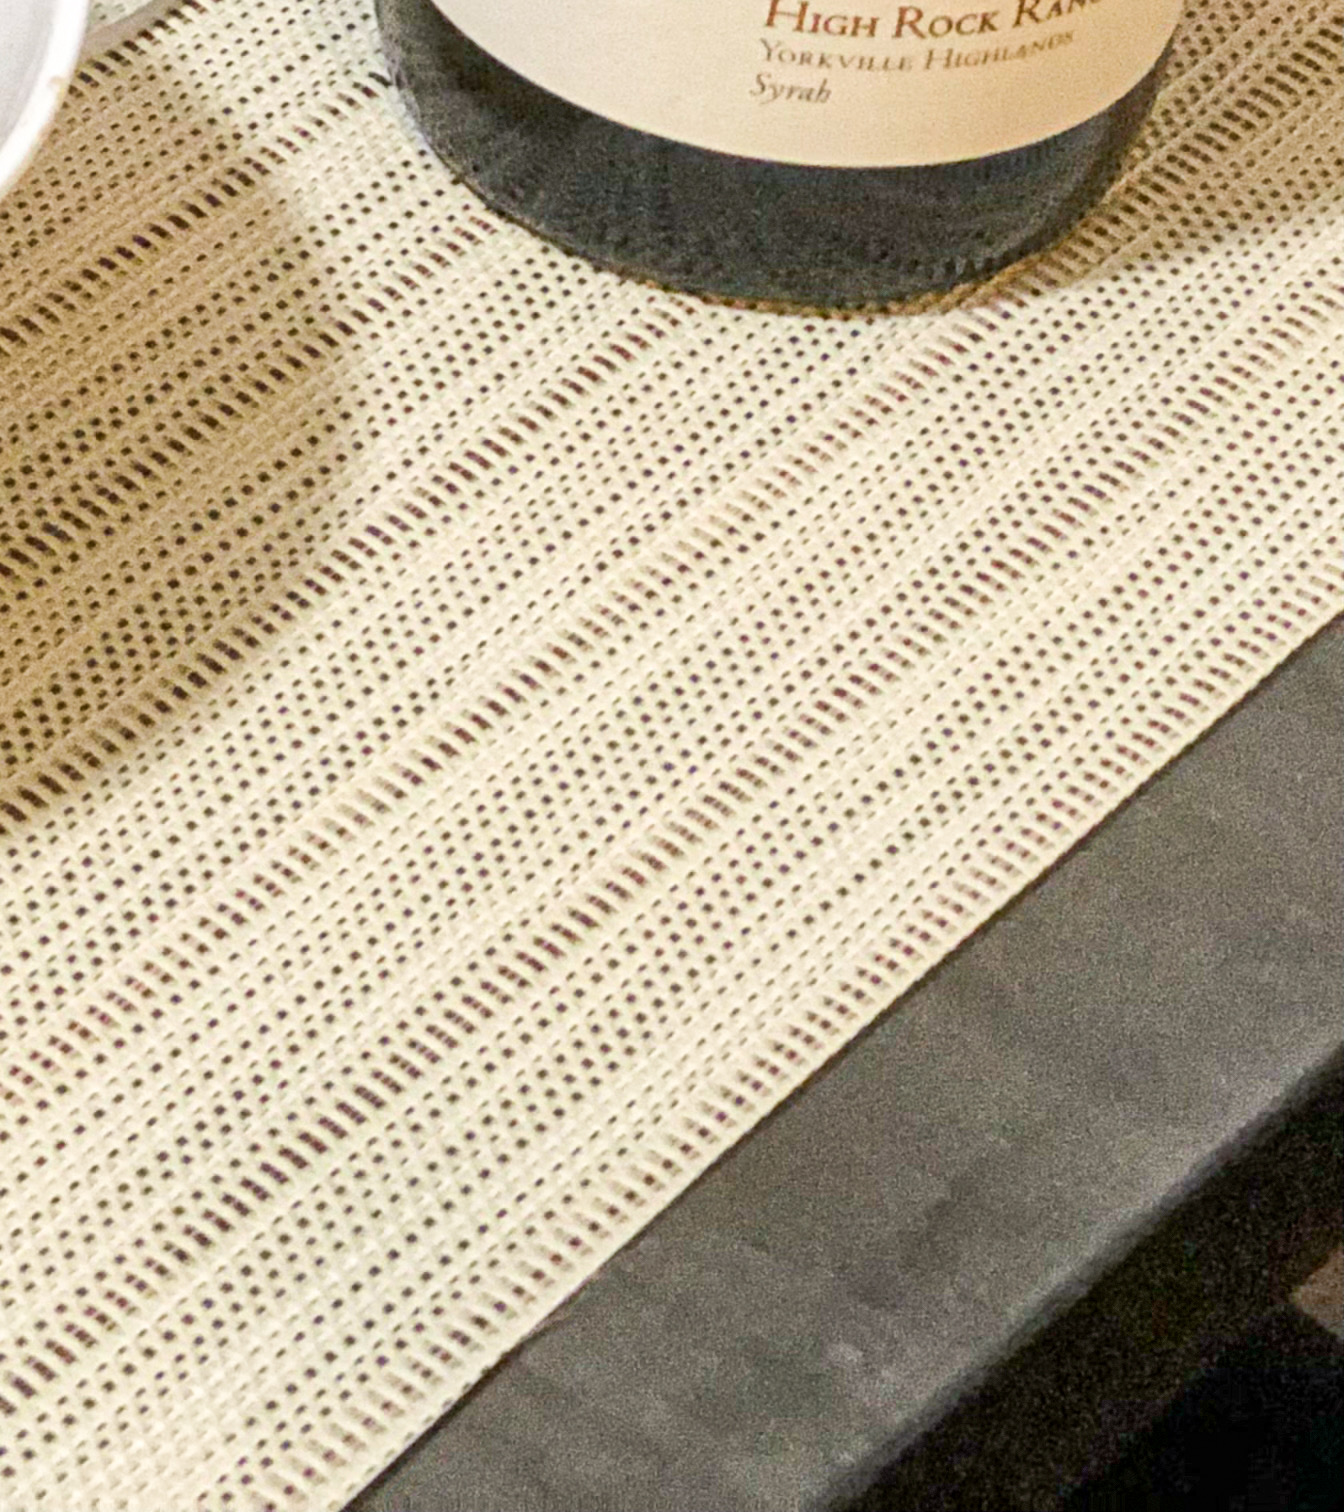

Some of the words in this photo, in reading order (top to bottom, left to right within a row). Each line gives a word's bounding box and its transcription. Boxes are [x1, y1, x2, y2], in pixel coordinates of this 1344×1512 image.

[891, 5, 1003, 39] ROCK
[759, 38, 913, 72] YORKVILLE
[923, 29, 1075, 70] HIGHLANDS
[749, 73, 831, 105] Syrah
